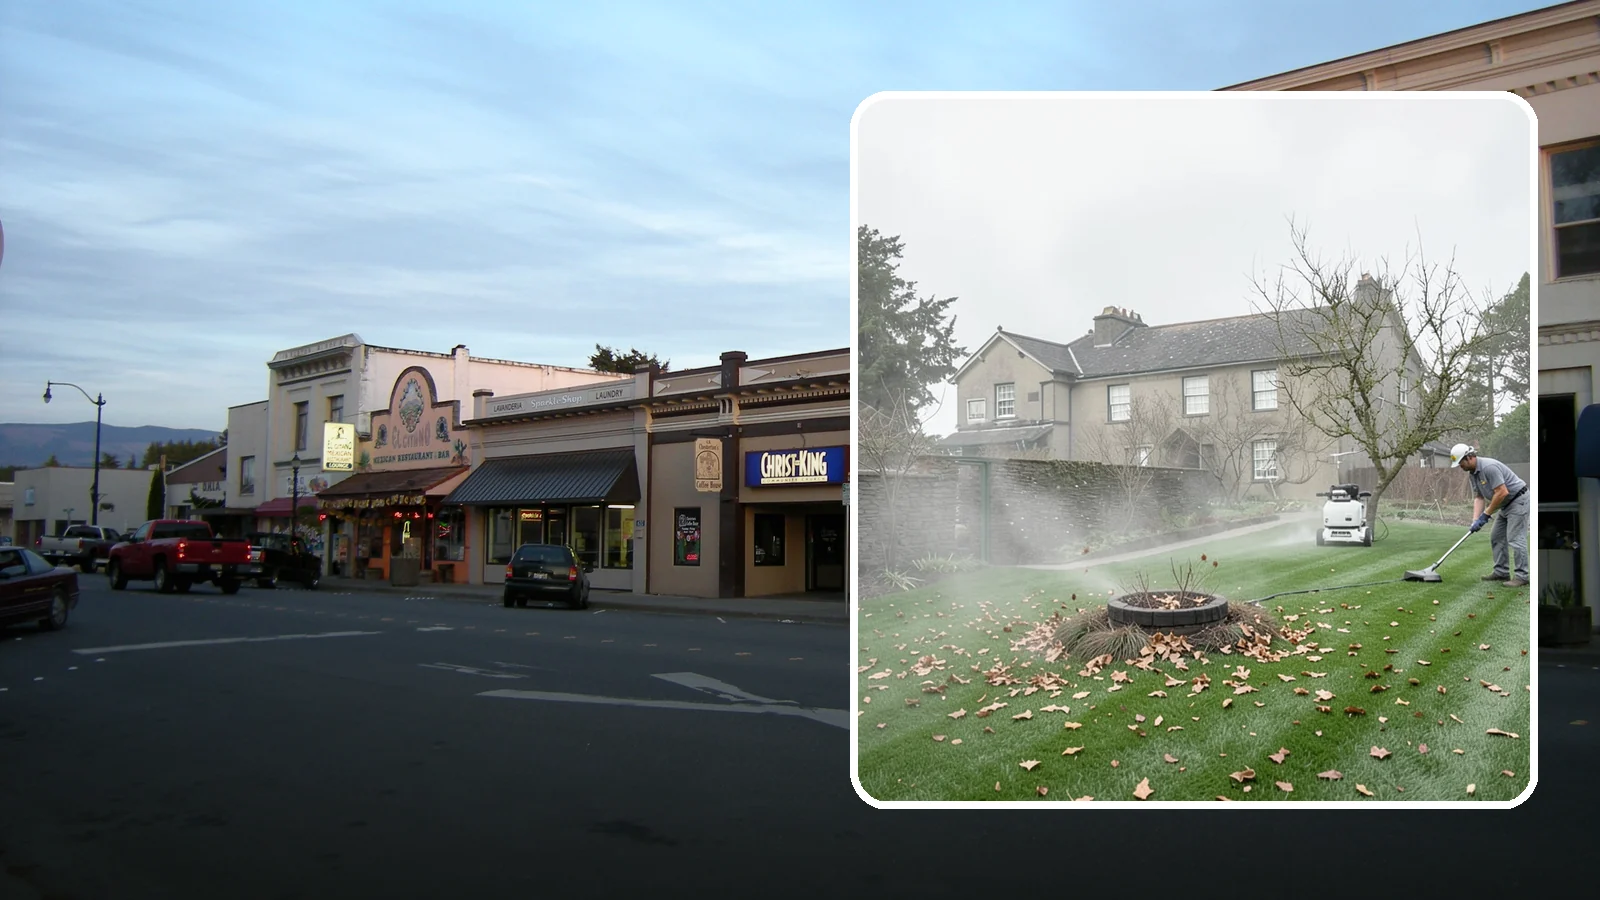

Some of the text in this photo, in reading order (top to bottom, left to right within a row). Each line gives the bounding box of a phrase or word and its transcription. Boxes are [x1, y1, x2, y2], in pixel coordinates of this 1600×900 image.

[595, 389, 623, 400] LAUNDRY
[493, 402, 522, 413] LAVANDERIA
[531, 395, 582, 409] Sparkle Shop
[373, 455, 396, 464] MEXICAN
[397, 451, 433, 462] RESTAURANT
[438, 450, 450, 459] BAR
[761, 450, 828, 478] CHRIST KING
